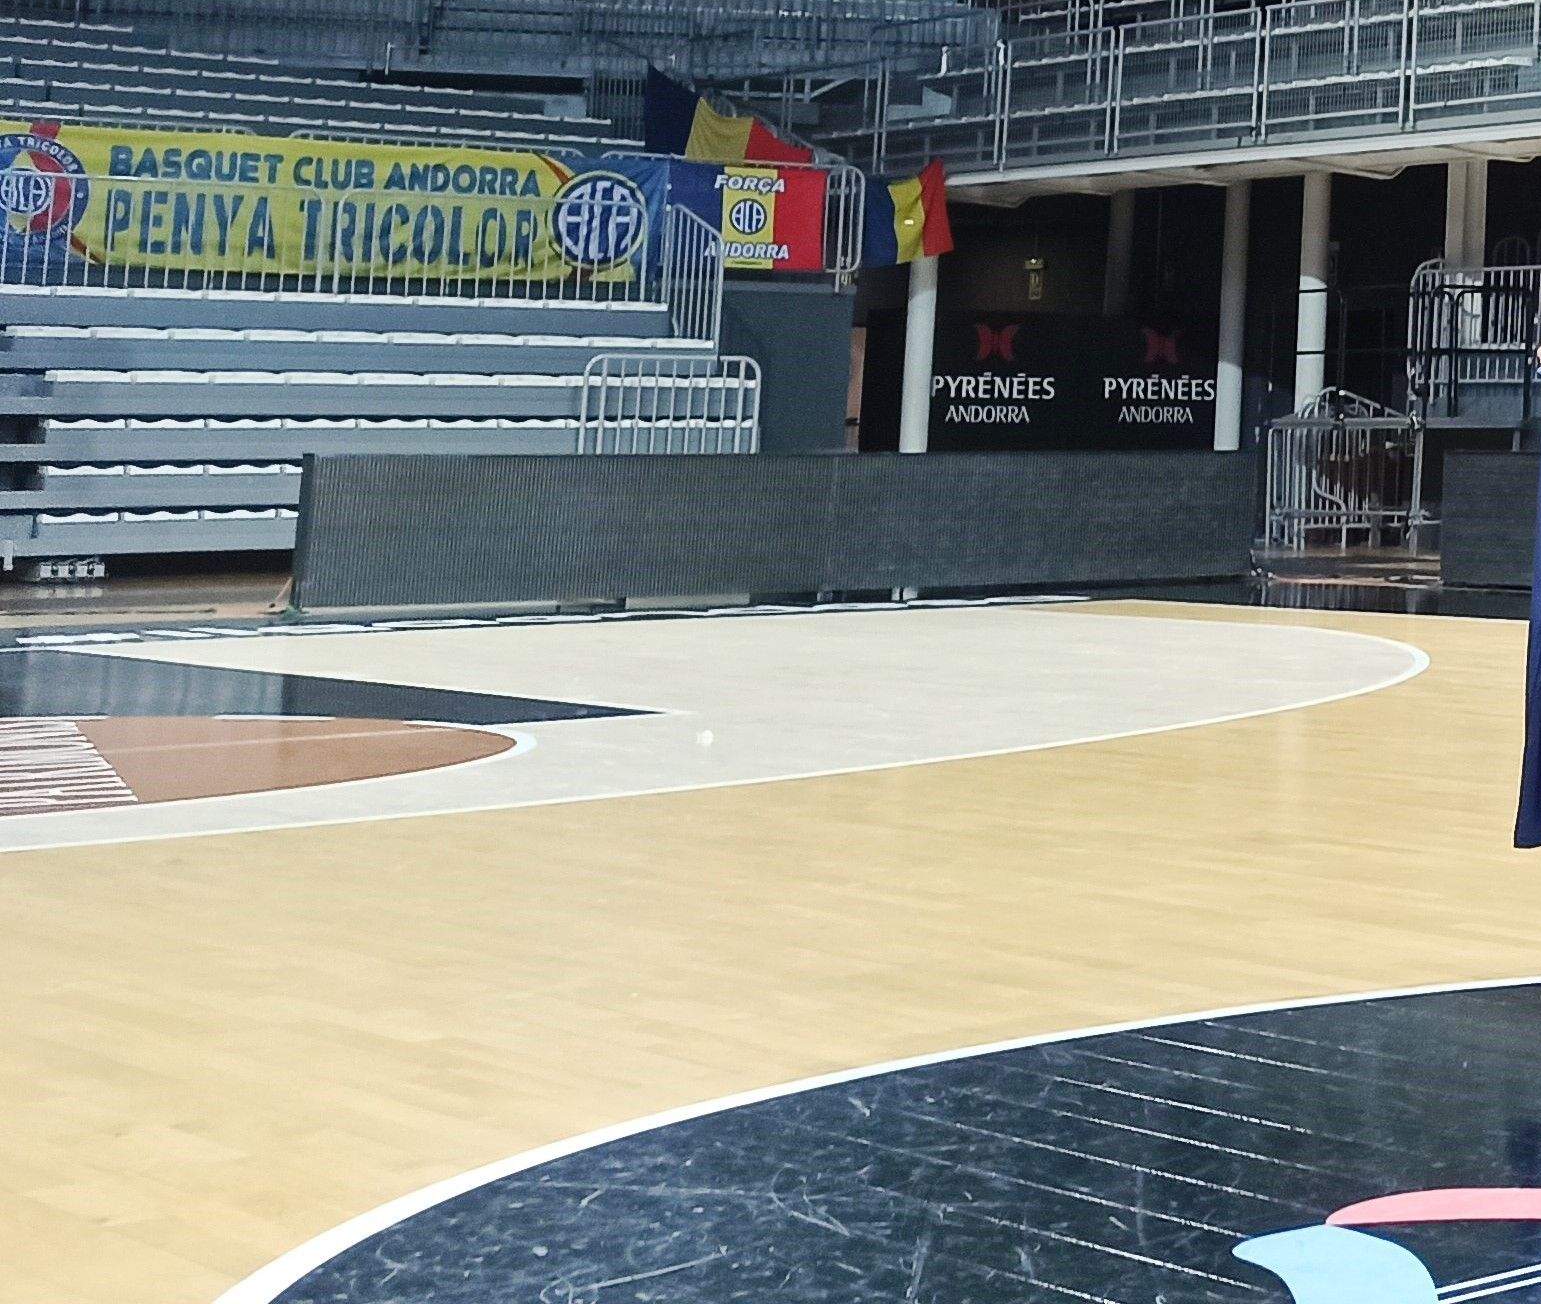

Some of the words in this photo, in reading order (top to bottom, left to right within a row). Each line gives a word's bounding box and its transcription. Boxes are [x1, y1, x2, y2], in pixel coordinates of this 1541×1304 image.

[109, 144, 284, 184] BASQUET
[293, 156, 375, 190] CLUB
[384, 162, 541, 197] ANDORRA
[714, 174, 785, 195] FORÇA
[105, 189, 276, 260] PENYA
[944, 405, 1031, 424] ANDORRA
[1117, 406, 1194, 424] ANDORRA
